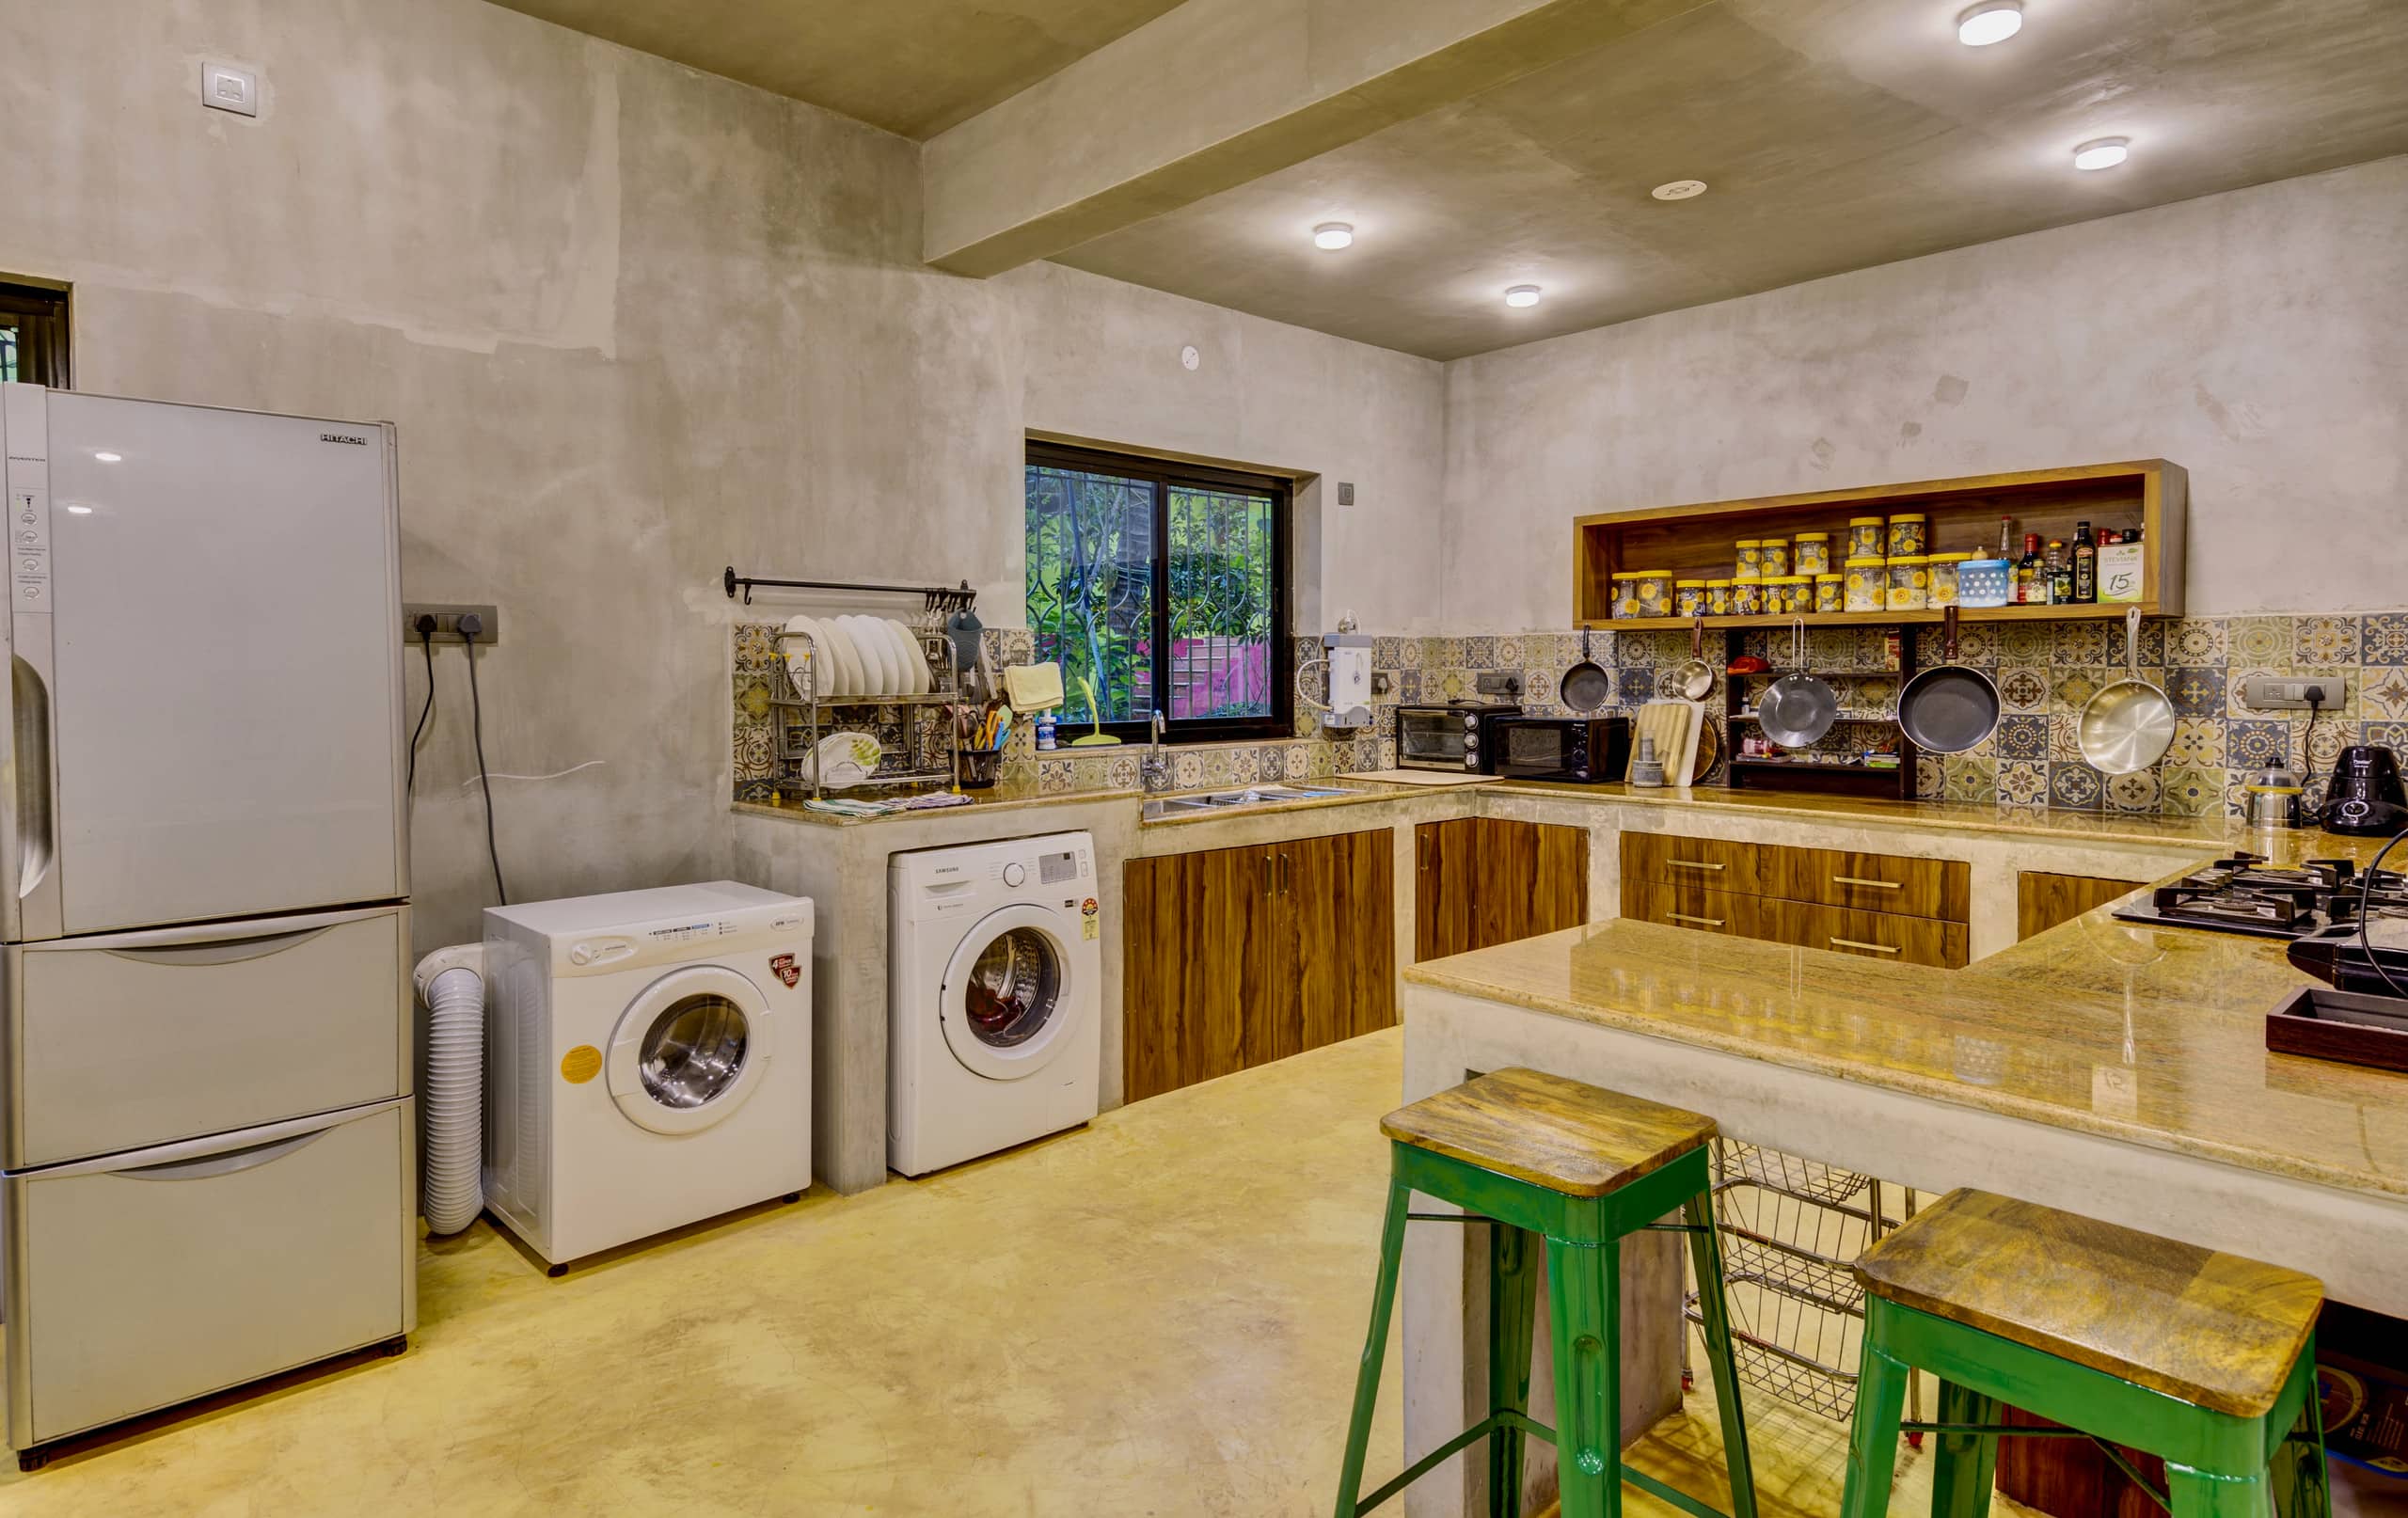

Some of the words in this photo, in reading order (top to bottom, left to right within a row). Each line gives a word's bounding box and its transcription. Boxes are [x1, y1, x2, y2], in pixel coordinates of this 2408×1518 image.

[320, 433, 368, 445] HITACHI
[2110, 572, 2134, 591] 15
[783, 969, 793, 978] 10
